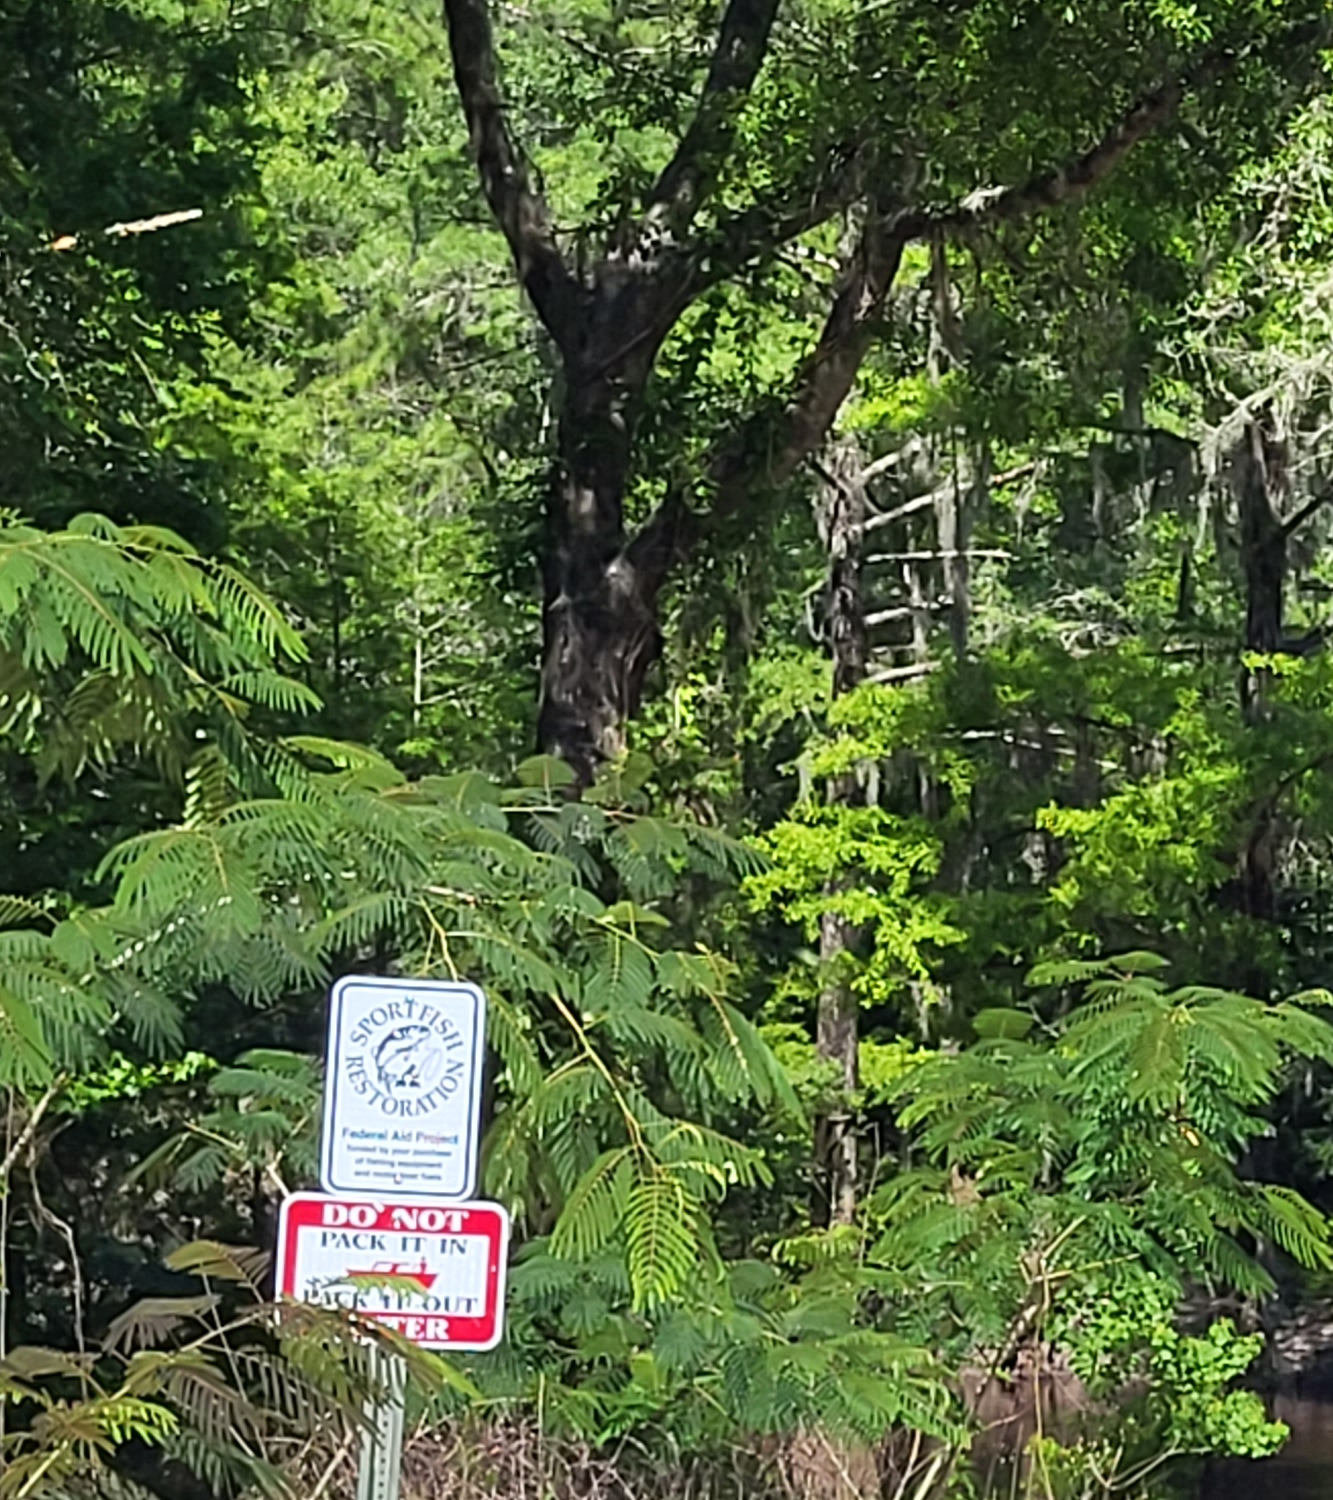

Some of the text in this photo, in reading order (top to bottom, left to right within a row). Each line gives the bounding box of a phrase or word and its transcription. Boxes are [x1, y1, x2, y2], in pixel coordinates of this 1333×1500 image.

[344, 1055, 465, 1118] RESTORATION
[342, 1127, 459, 1146] Federal Aid Project
[322, 1203, 470, 1233] DO NOT
[321, 1231, 469, 1255] PACK IT IN
[422, 1295, 479, 1314] OUT
